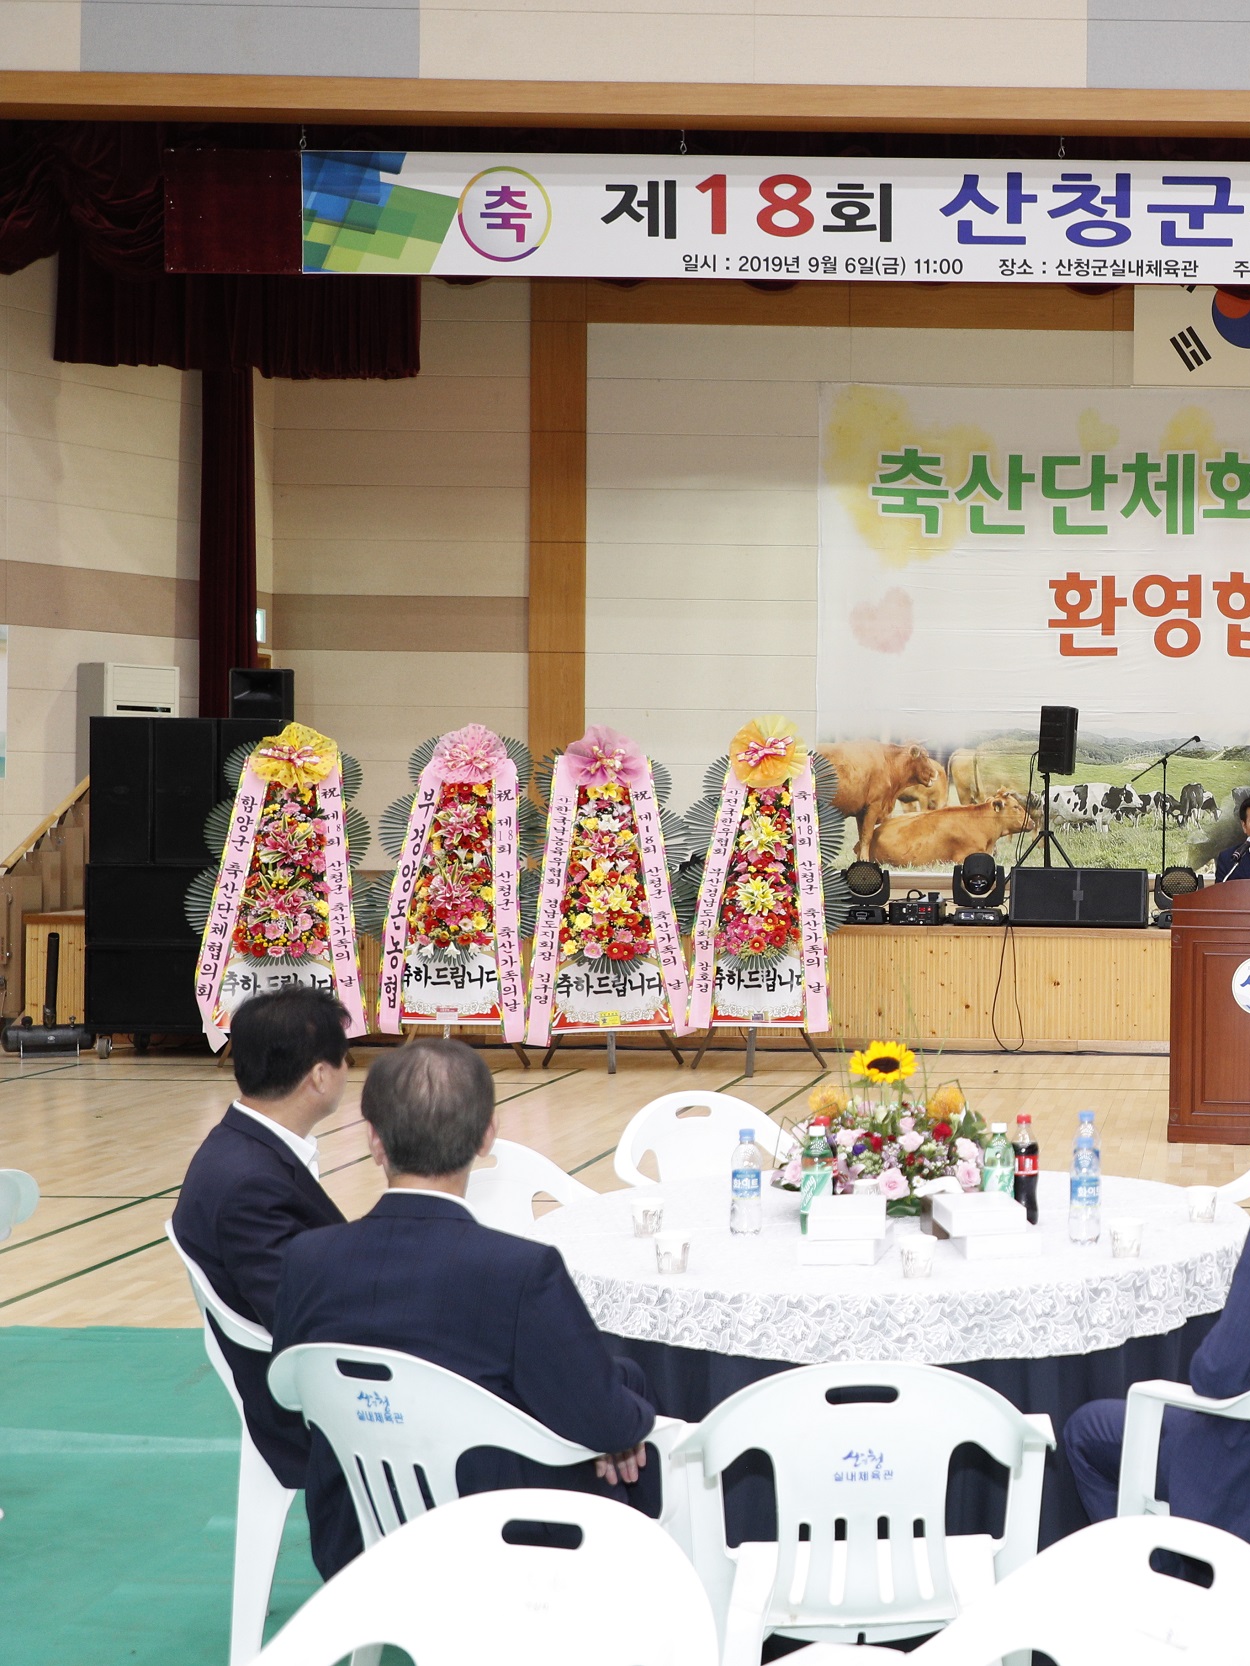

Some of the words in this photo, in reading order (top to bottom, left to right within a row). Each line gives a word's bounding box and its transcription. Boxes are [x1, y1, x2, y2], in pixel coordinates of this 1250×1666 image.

[480, 185, 528, 243] 축
[601, 173, 892, 242] 제18회
[682, 254, 718, 273] 일시
[738, 255, 802, 274] 2019년
[808, 256, 838, 275] 9월
[844, 256, 907, 276] 6일(금)
[913, 258, 965, 276] 11:00
[998, 258, 1036, 277] 장소
[1054, 258, 1200, 279] 산청군실내체육관
[321, 787, 341, 800] 祝
[496, 789, 515, 802] 祝
[633, 789, 653, 802] 祝
[795, 789, 812, 802] 축
[231, 794, 258, 853] 함양군
[496, 815, 515, 855] 제18회
[637, 811, 658, 855] 제18회
[796, 812, 815, 849] 제18회
[328, 860, 347, 896] 산청군
[497, 870, 515, 911] 산청군
[646, 865, 667, 900] 산청군
[798, 859, 819, 897] 산청군
[384, 787, 436, 1010] 부경양돈농협
[197, 861, 244, 1002] 축산단체협의회
[330, 901, 353, 962] 축산가족의
[654, 910, 679, 967] 축산가족의
[803, 907, 823, 969] 축산가족의
[338, 974, 356, 989] 날
[556, 971, 663, 999] 축하드립니다
[667, 978, 686, 992] 날
[715, 966, 803, 994] 축하드립니
[807, 980, 826, 994] 날
